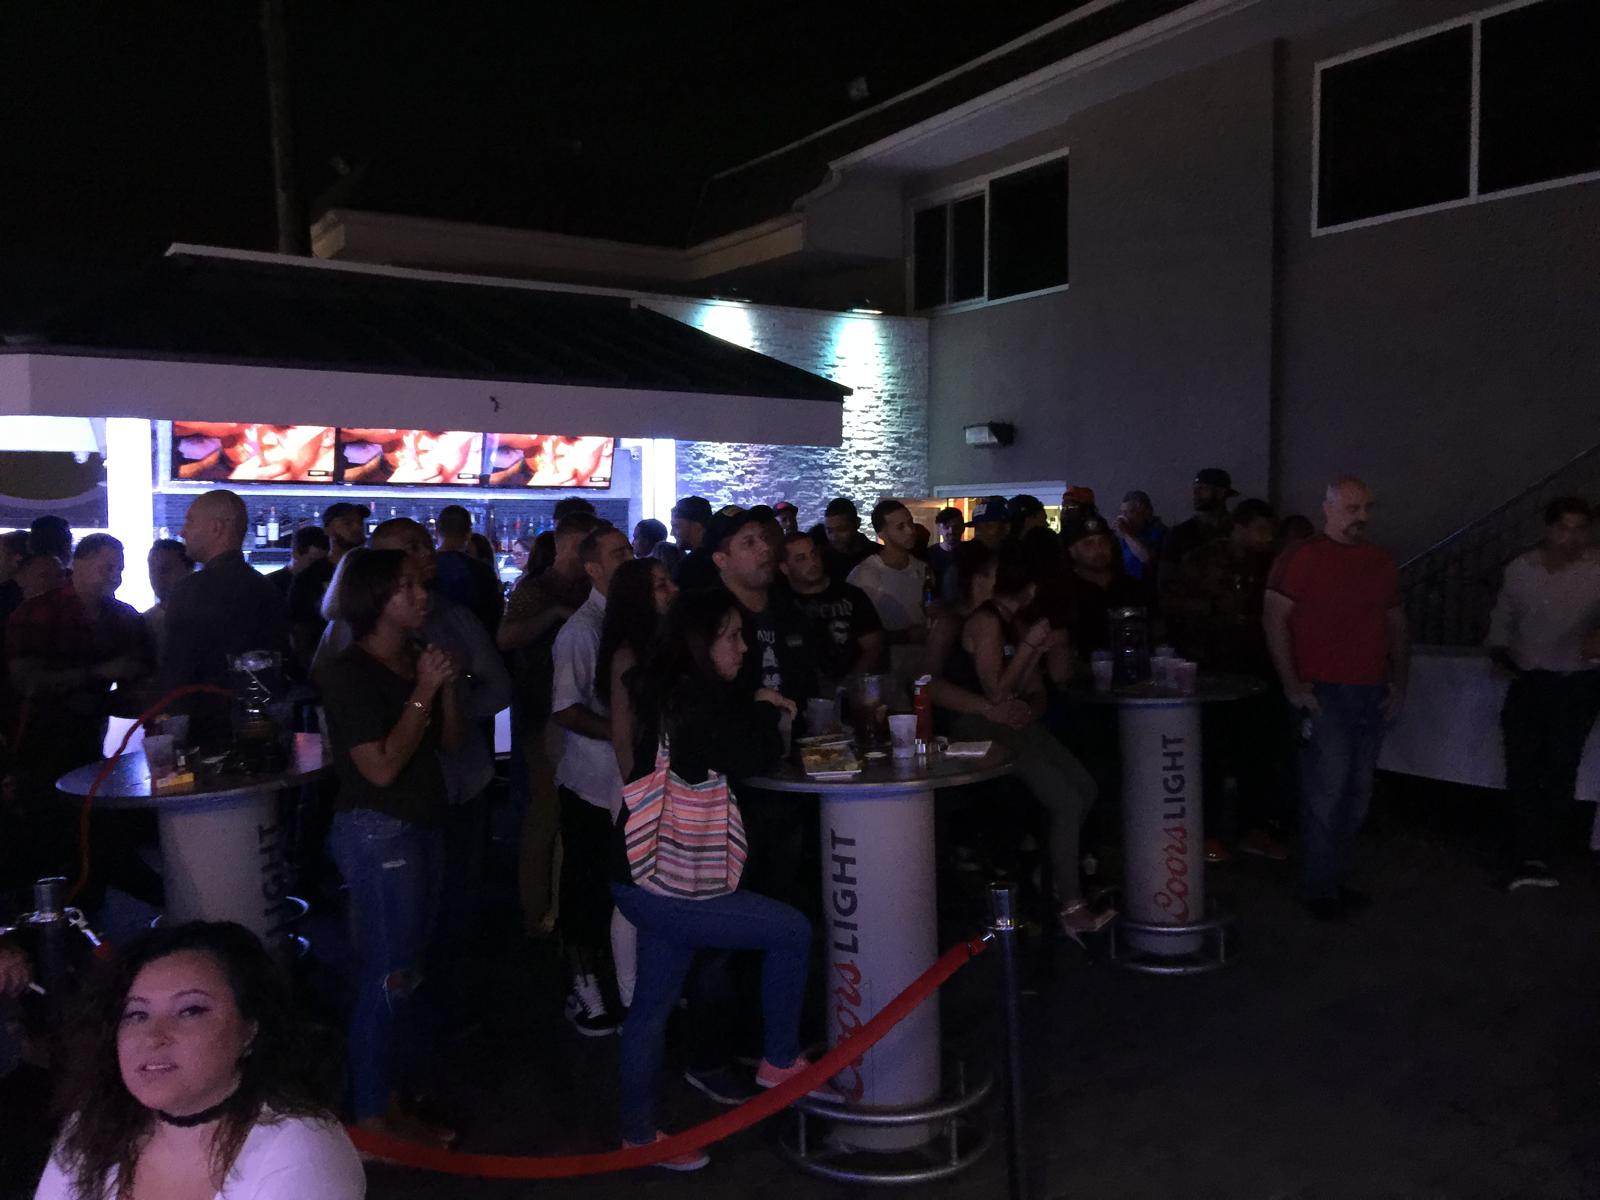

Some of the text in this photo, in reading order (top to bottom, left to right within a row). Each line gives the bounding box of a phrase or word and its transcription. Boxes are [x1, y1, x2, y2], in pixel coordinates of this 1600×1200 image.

[1153, 734, 1190, 924] Coors LIGHT
[827, 828, 865, 1101] Cors LIGHT
